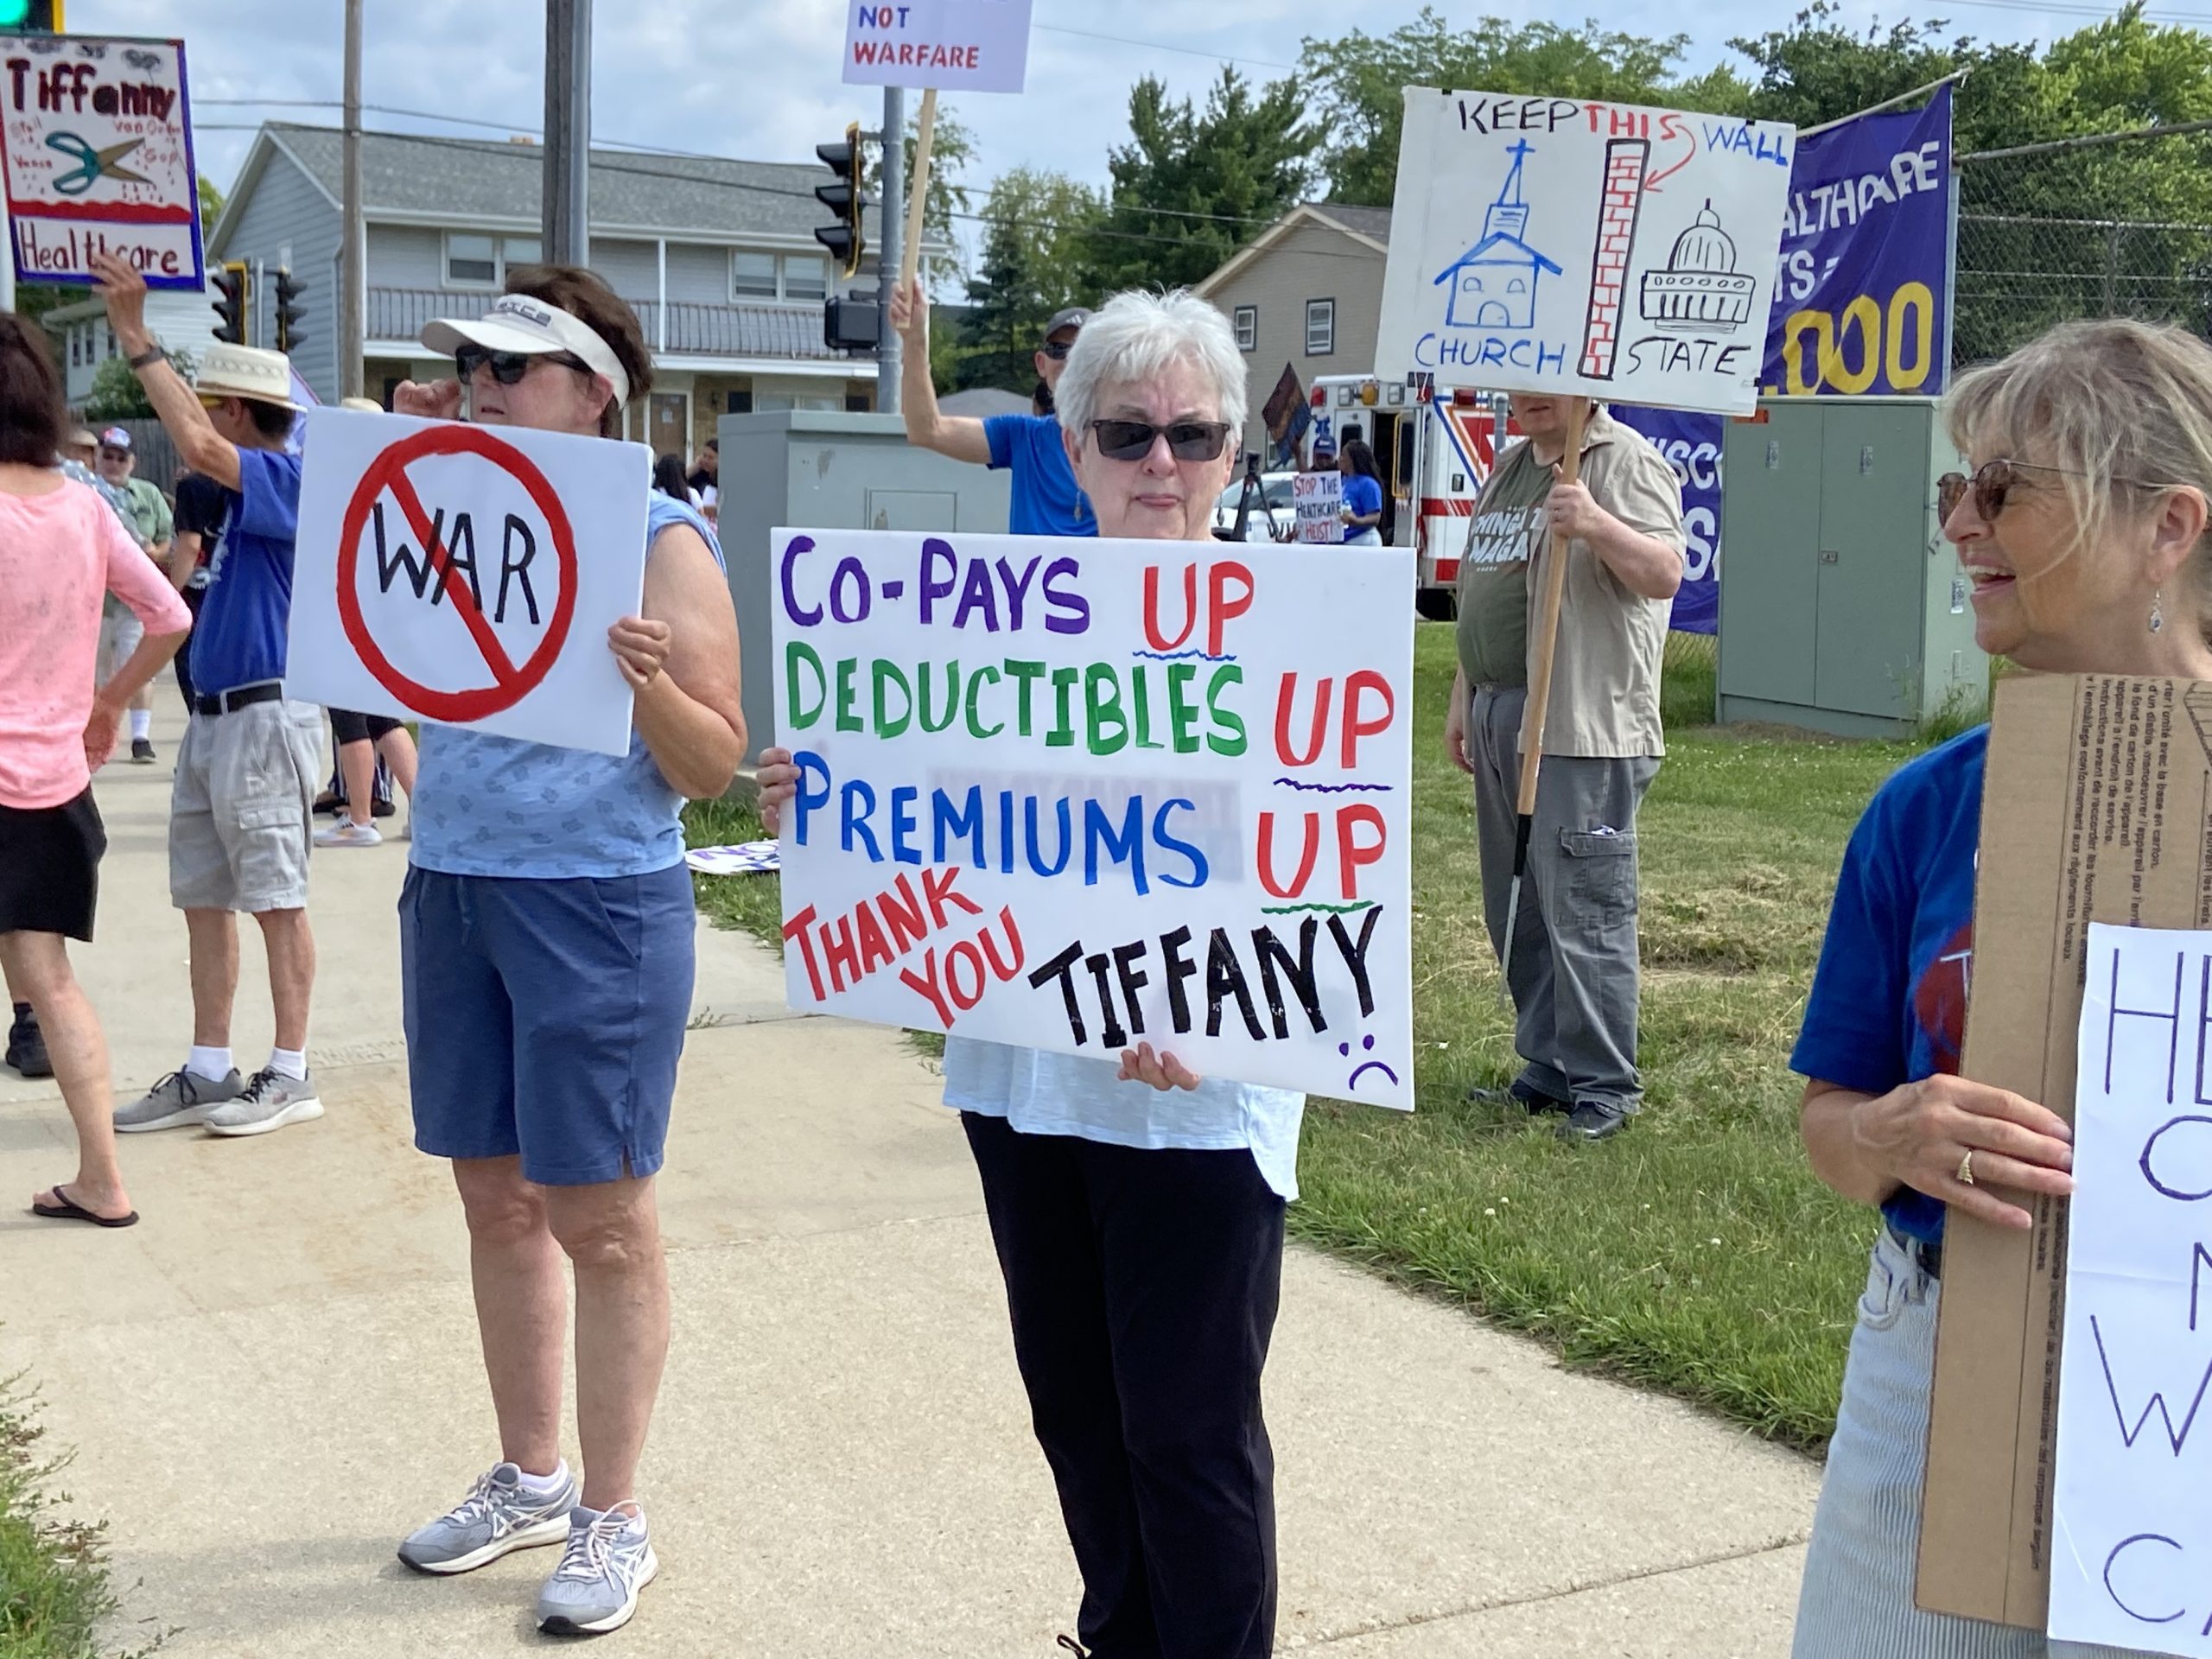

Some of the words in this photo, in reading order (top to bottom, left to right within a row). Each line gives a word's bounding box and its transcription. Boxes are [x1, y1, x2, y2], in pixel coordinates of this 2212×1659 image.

[859, 6, 910, 29] NOT
[854, 41, 980, 69] WARFARE
[6, 57, 175, 122] Tiffany
[1457, 99, 1580, 136] KEEP
[1584, 105, 1682, 141] THIS
[1702, 121, 1789, 167] WALL
[1414, 333, 1566, 376] CHURCH
[1626, 336, 1751, 375] STATE
[1294, 475, 1318, 497] STOP
[1320, 477, 1338, 495] THE
[1296, 500, 1342, 518] HEALTHCARE
[1305, 518, 1333, 541] HEIST!
[1469, 531, 1529, 563] MAGA
[372, 501, 541, 626] WAR
[781, 535, 1090, 635] CO-PAYS
[1143, 560, 1254, 658] UP
[785, 640, 1248, 757] DEDUCTIBLES
[1274, 670, 1395, 770] UP
[793, 750, 1209, 896] PREMIUMS
[1256, 803, 1387, 900] UP
[782, 866, 983, 1002] THANK
[899, 904, 1025, 1030] YOU
[1027, 904, 1384, 1049] TIFFANY
